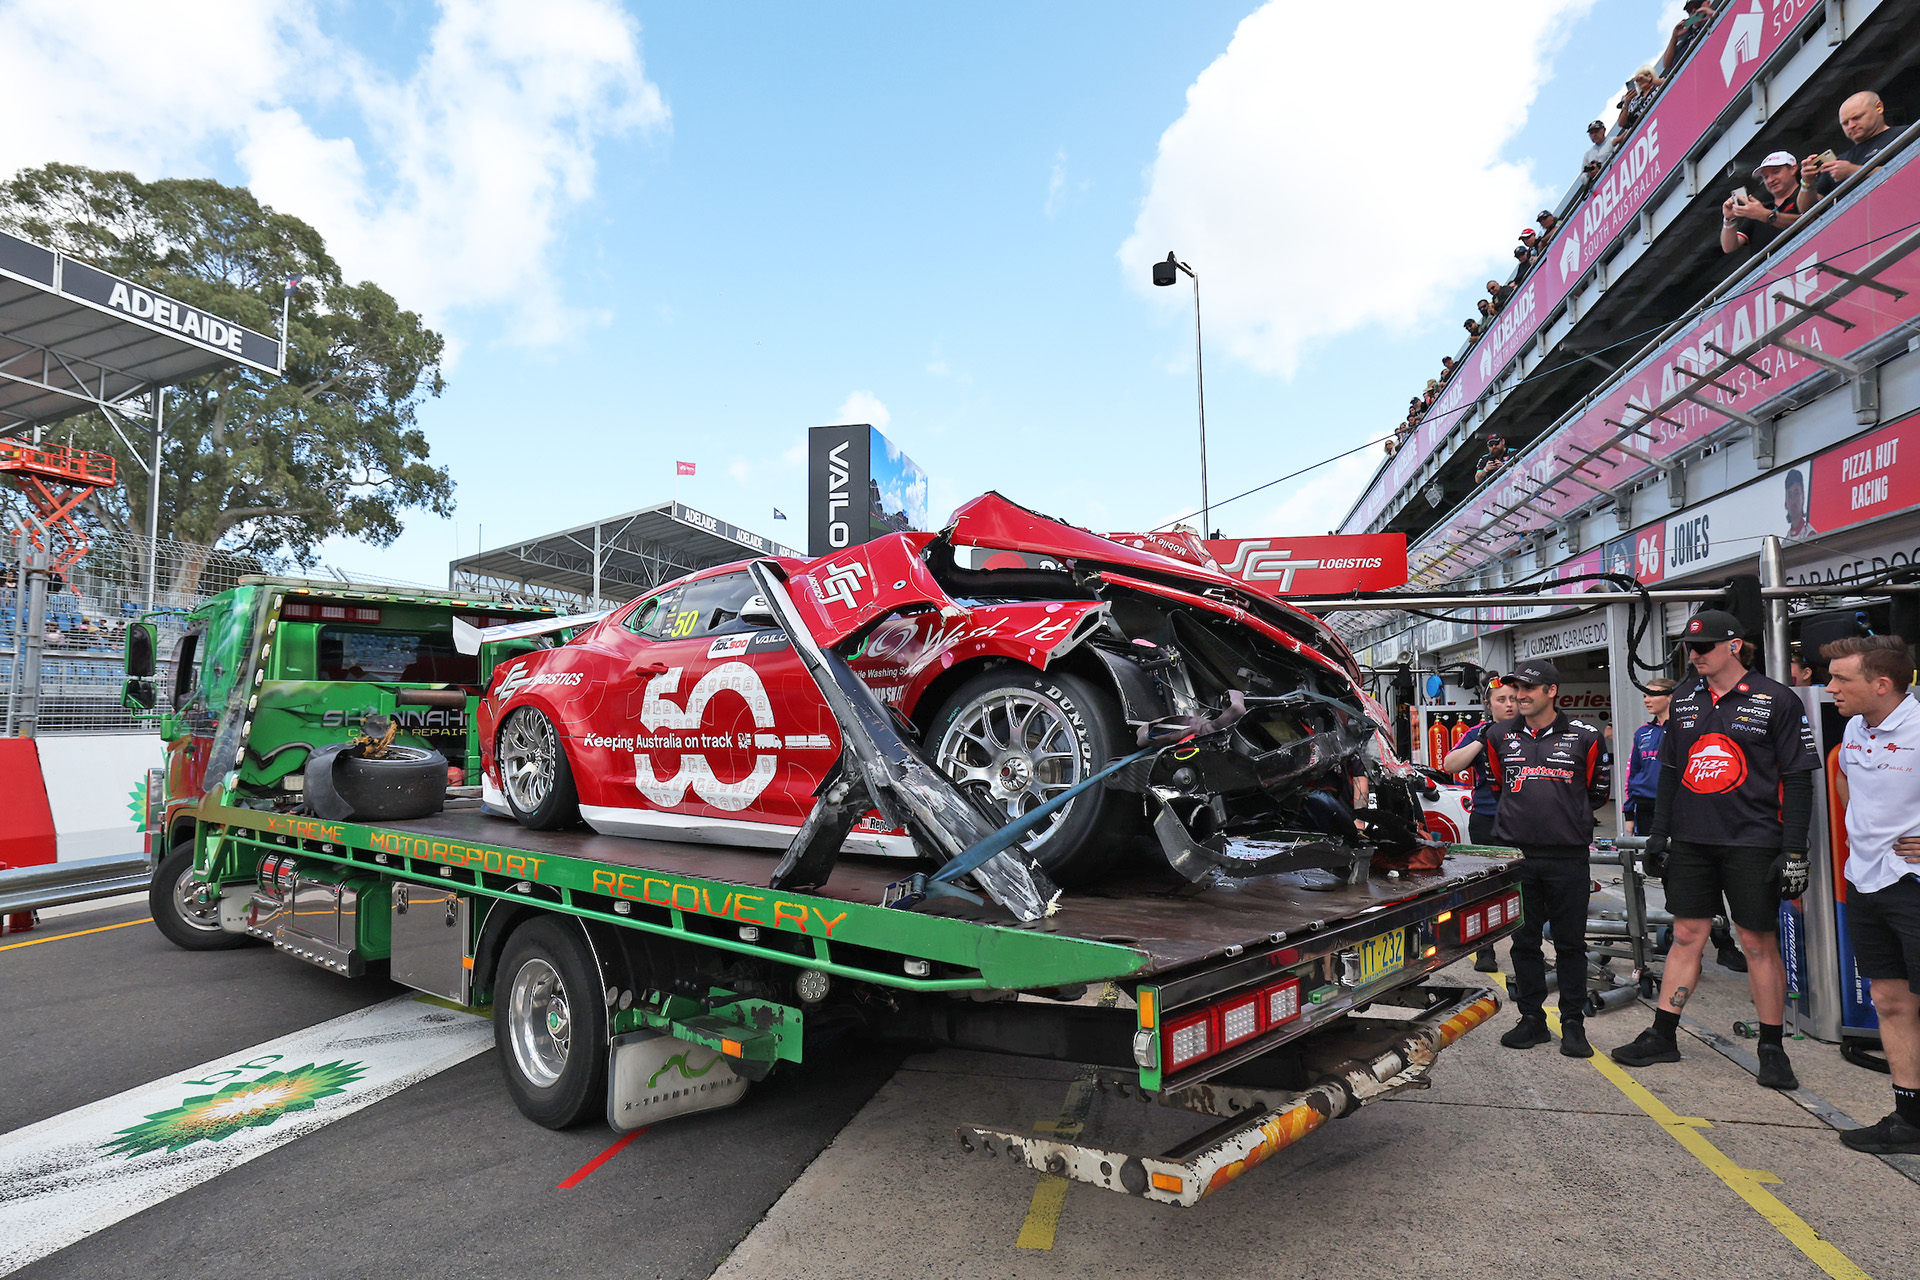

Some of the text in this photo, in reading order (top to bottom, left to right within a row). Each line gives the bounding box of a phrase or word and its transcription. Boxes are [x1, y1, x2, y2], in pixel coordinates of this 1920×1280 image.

[1583, 117, 1661, 243] ADELAIDE
[1584, 160, 1661, 262] SOUTH AUSTRALIA
[107, 282, 243, 354] ADELAIDE
[1493, 281, 1536, 358] ADELAIDE
[1660, 251, 1818, 403] ADELAIDE
[1660, 403, 1709, 444] SOUTH
[1842, 438, 1899, 482] PIZZA HUT
[828, 440, 850, 548] VAILO
[1851, 475, 1889, 511] RACING
[684, 508, 717, 532] ADELAIDE
[735, 528, 763, 549] ADELAIDE
[1638, 535, 1660, 578] 96
[1671, 514, 1710, 569] JONES
[1319, 556, 1382, 572] LOGISTICS
[671, 610, 699, 637] 50
[755, 633, 787, 645] VAILO
[1563, 627, 1593, 649] GARAGE
[1594, 622, 1608, 643] DO
[868, 667, 898, 679] Washing
[411, 728, 468, 737] REPAIR
[584, 731, 734, 753] Keeping Australia on track
[1521, 766, 1574, 778] Batteries
[1695, 767, 1727, 783] Hut
[266, 816, 847, 937] X-TREME MOTORSPORT RECOVERY
[1787, 913, 1798, 973] NITROGEN
